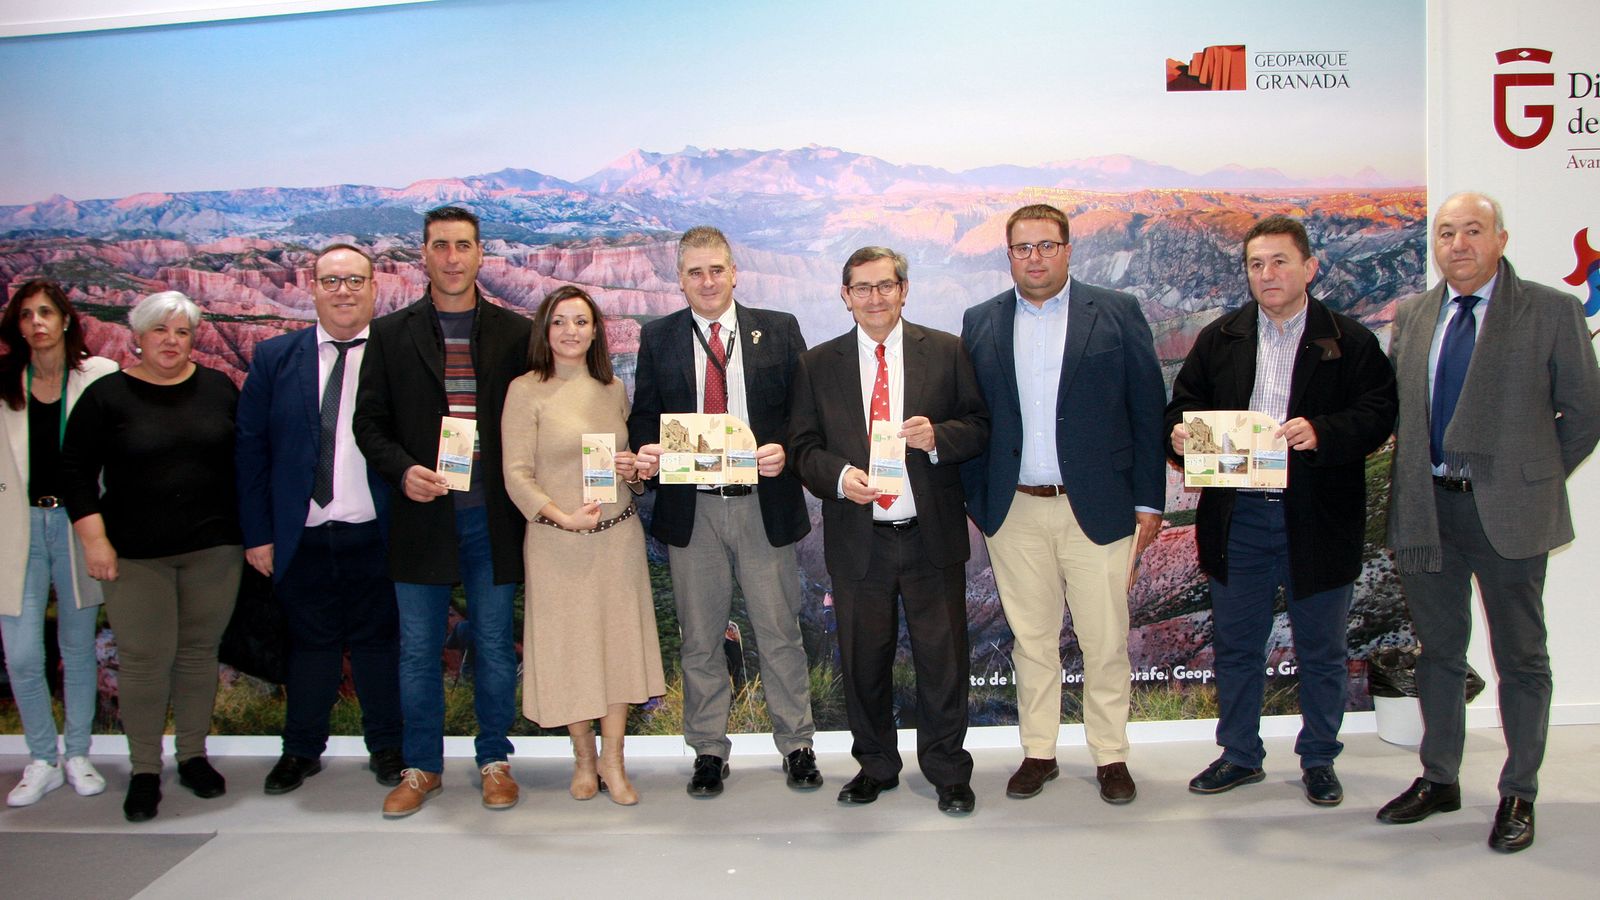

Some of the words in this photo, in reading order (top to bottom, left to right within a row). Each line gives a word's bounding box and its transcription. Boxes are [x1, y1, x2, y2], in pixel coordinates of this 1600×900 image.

[1255, 53, 1347, 69] GEOPARQUE
[1256, 73, 1350, 90] GRANADA
[1567, 72, 1600, 99] Di
[1567, 107, 1599, 135] de
[969, 675, 985, 686] to
[989, 671, 1007, 686] de
[1173, 665, 1216, 684] Geop
[1265, 667, 1275, 676] e
[1278, 661, 1297, 675] Gr
